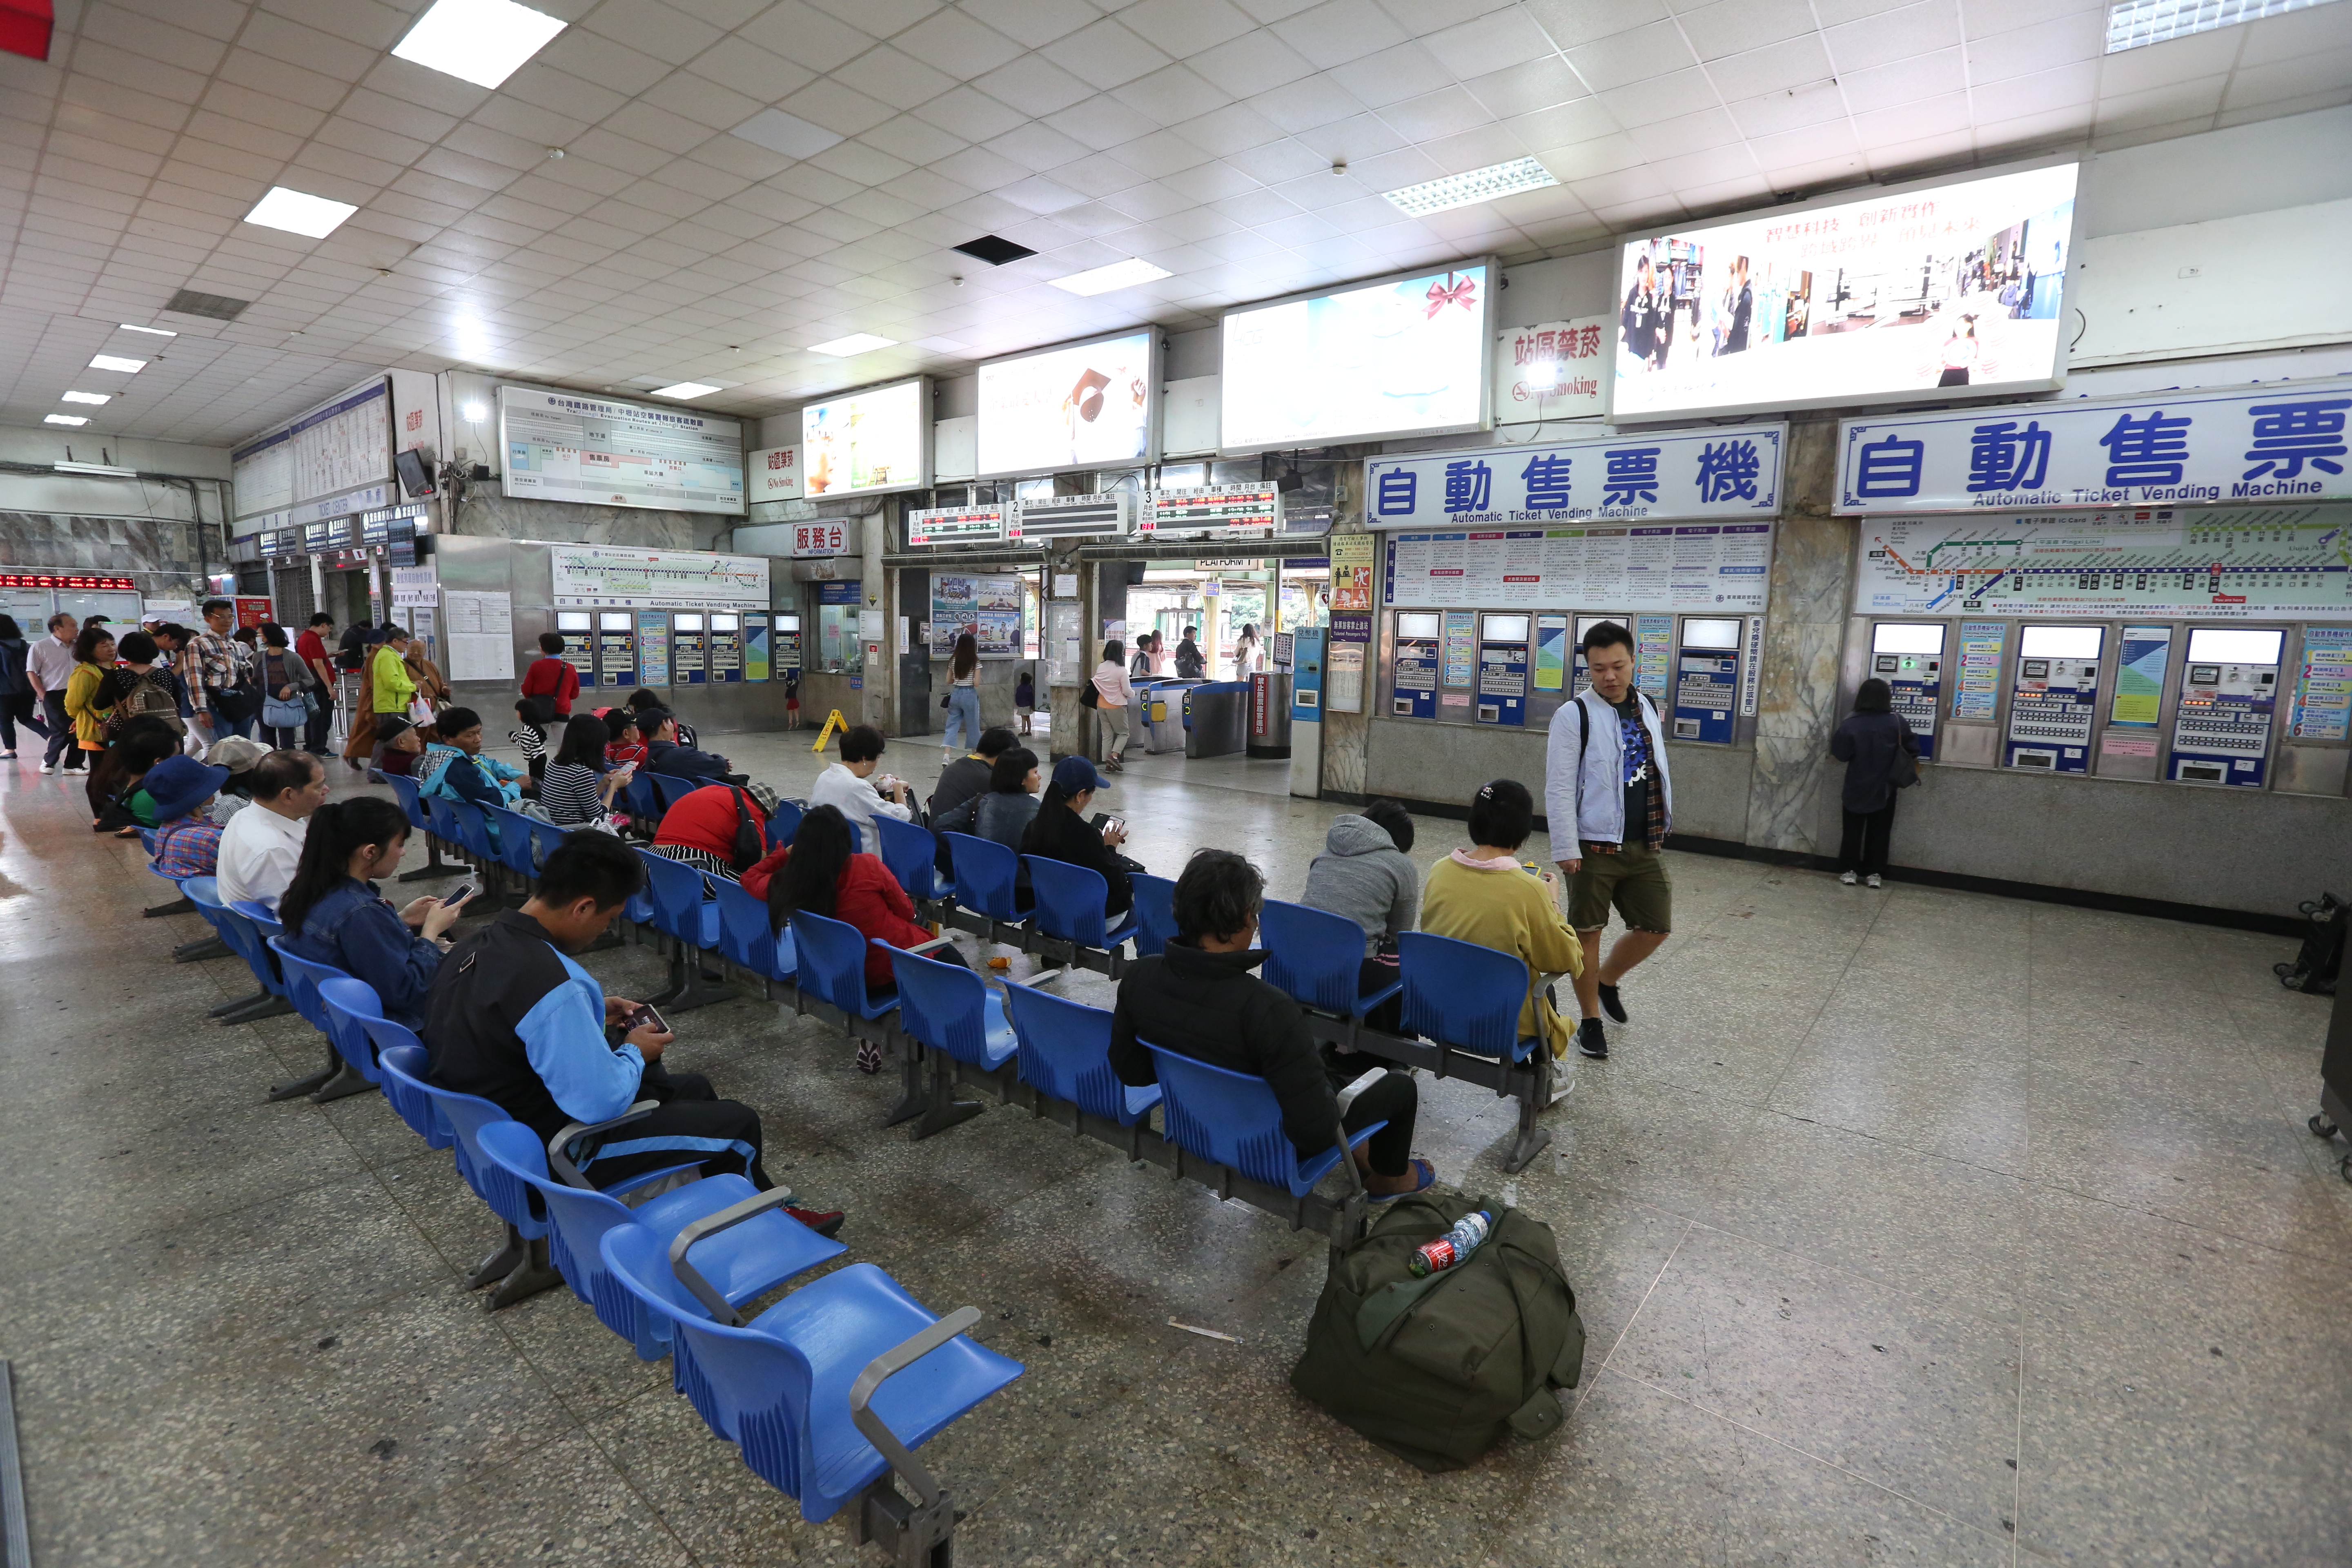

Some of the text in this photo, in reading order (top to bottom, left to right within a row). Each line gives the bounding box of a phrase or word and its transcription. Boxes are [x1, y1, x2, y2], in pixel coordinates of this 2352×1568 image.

[1766, 201, 1940, 243] 智慧科技 創新實作
[1515, 325, 1601, 366] 站區禁菸
[558, 399, 612, 414] 台灣鐵路管理局
[601, 413, 630, 421] Evacuation
[1857, 399, 2352, 498] 自動售票
[768, 450, 793, 470] 站區禁菸
[773, 477, 793, 488] No Smoking
[1379, 440, 1760, 515] 自動售票機
[1145, 491, 1152, 503] 3
[1974, 480, 2323, 506] Automatic Ticket Vending Machine
[1013, 501, 1018, 512] 2
[1452, 506, 1648, 523] Automatic Ticket Vending Machine
[797, 526, 842, 549] 服務台
[2091, 575, 2099, 588] 台北
[2315, 574, 2324, 588] 竹北
[1334, 621, 1368, 630] 無票旅客禁止進站
[1256, 677, 1264, 734] 禁止無票旅客進站
